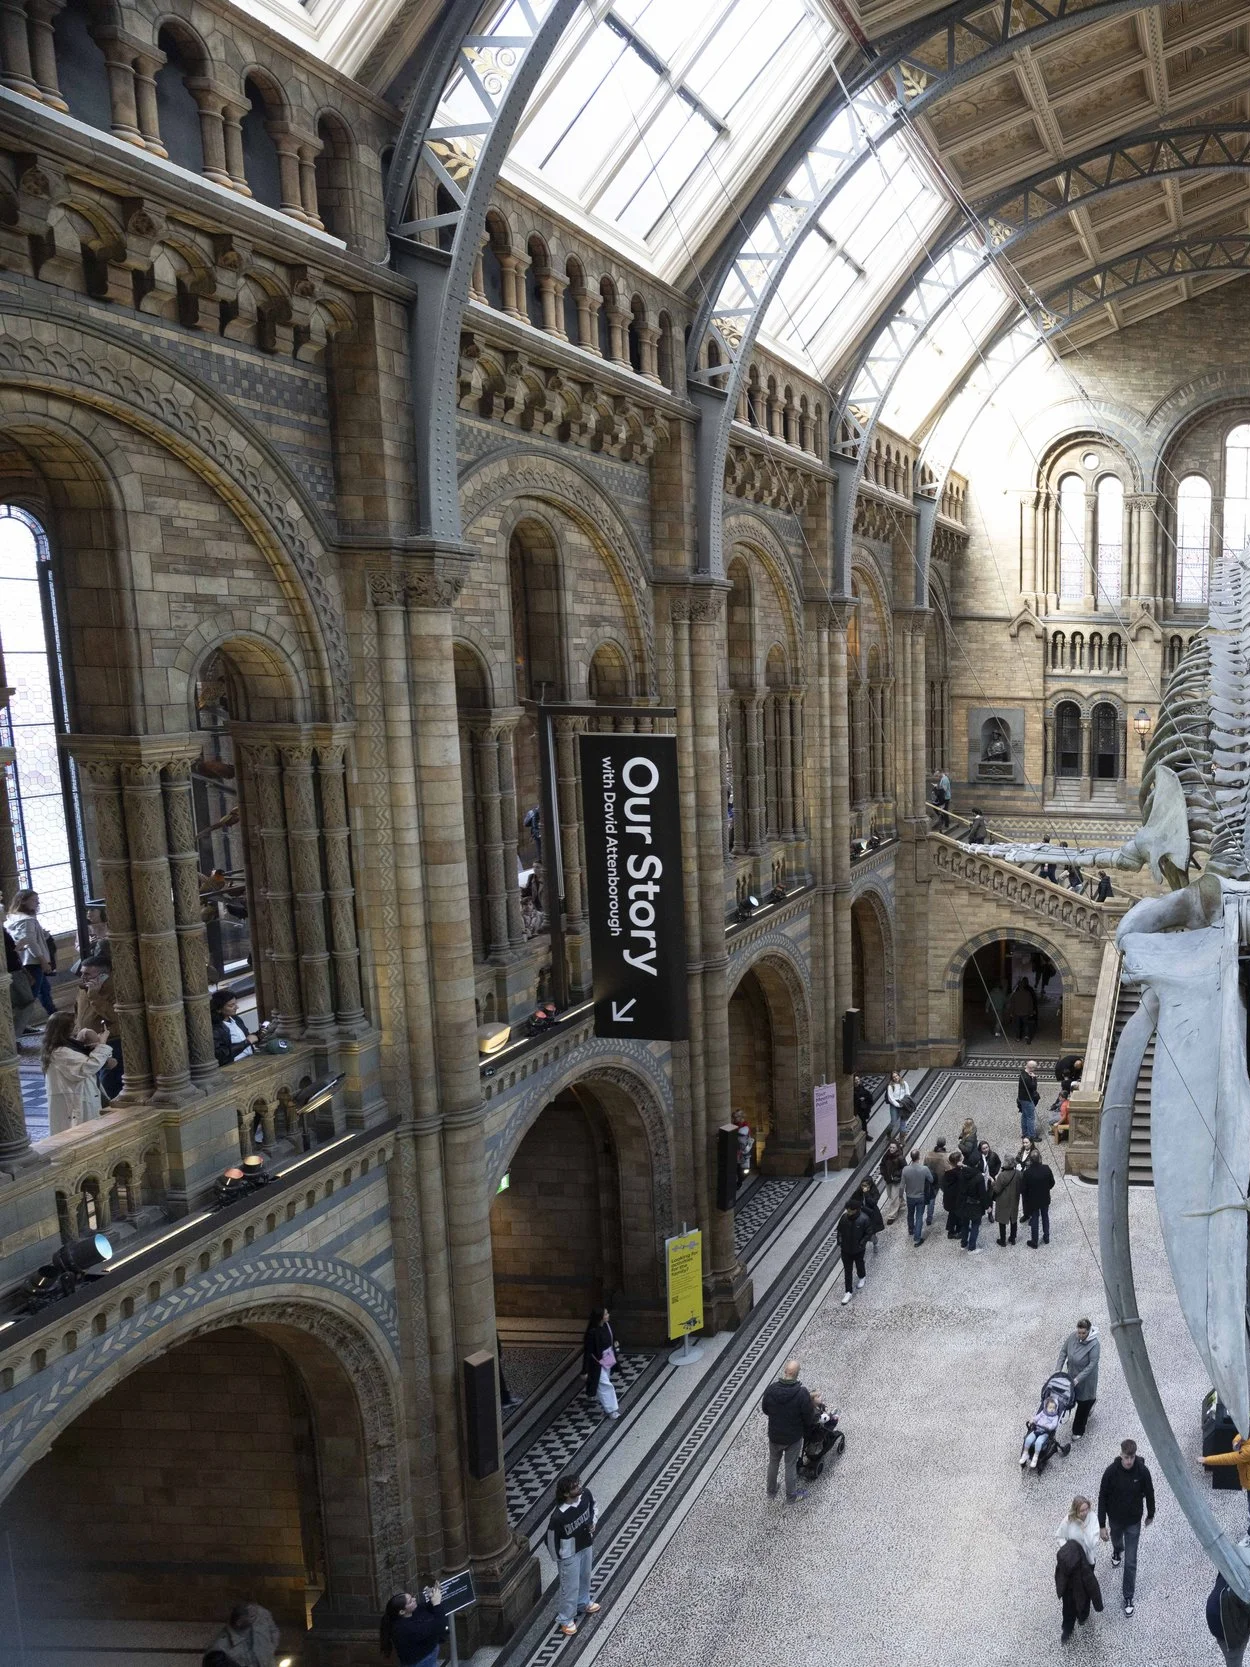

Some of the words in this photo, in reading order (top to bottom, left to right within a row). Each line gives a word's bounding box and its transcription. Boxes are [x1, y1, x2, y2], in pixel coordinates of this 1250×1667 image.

[602, 756, 615, 788] with
[604, 792, 618, 834] David
[622, 756, 659, 845] Our
[605, 836, 622, 937] Attenborough
[623, 854, 663, 977] Story
